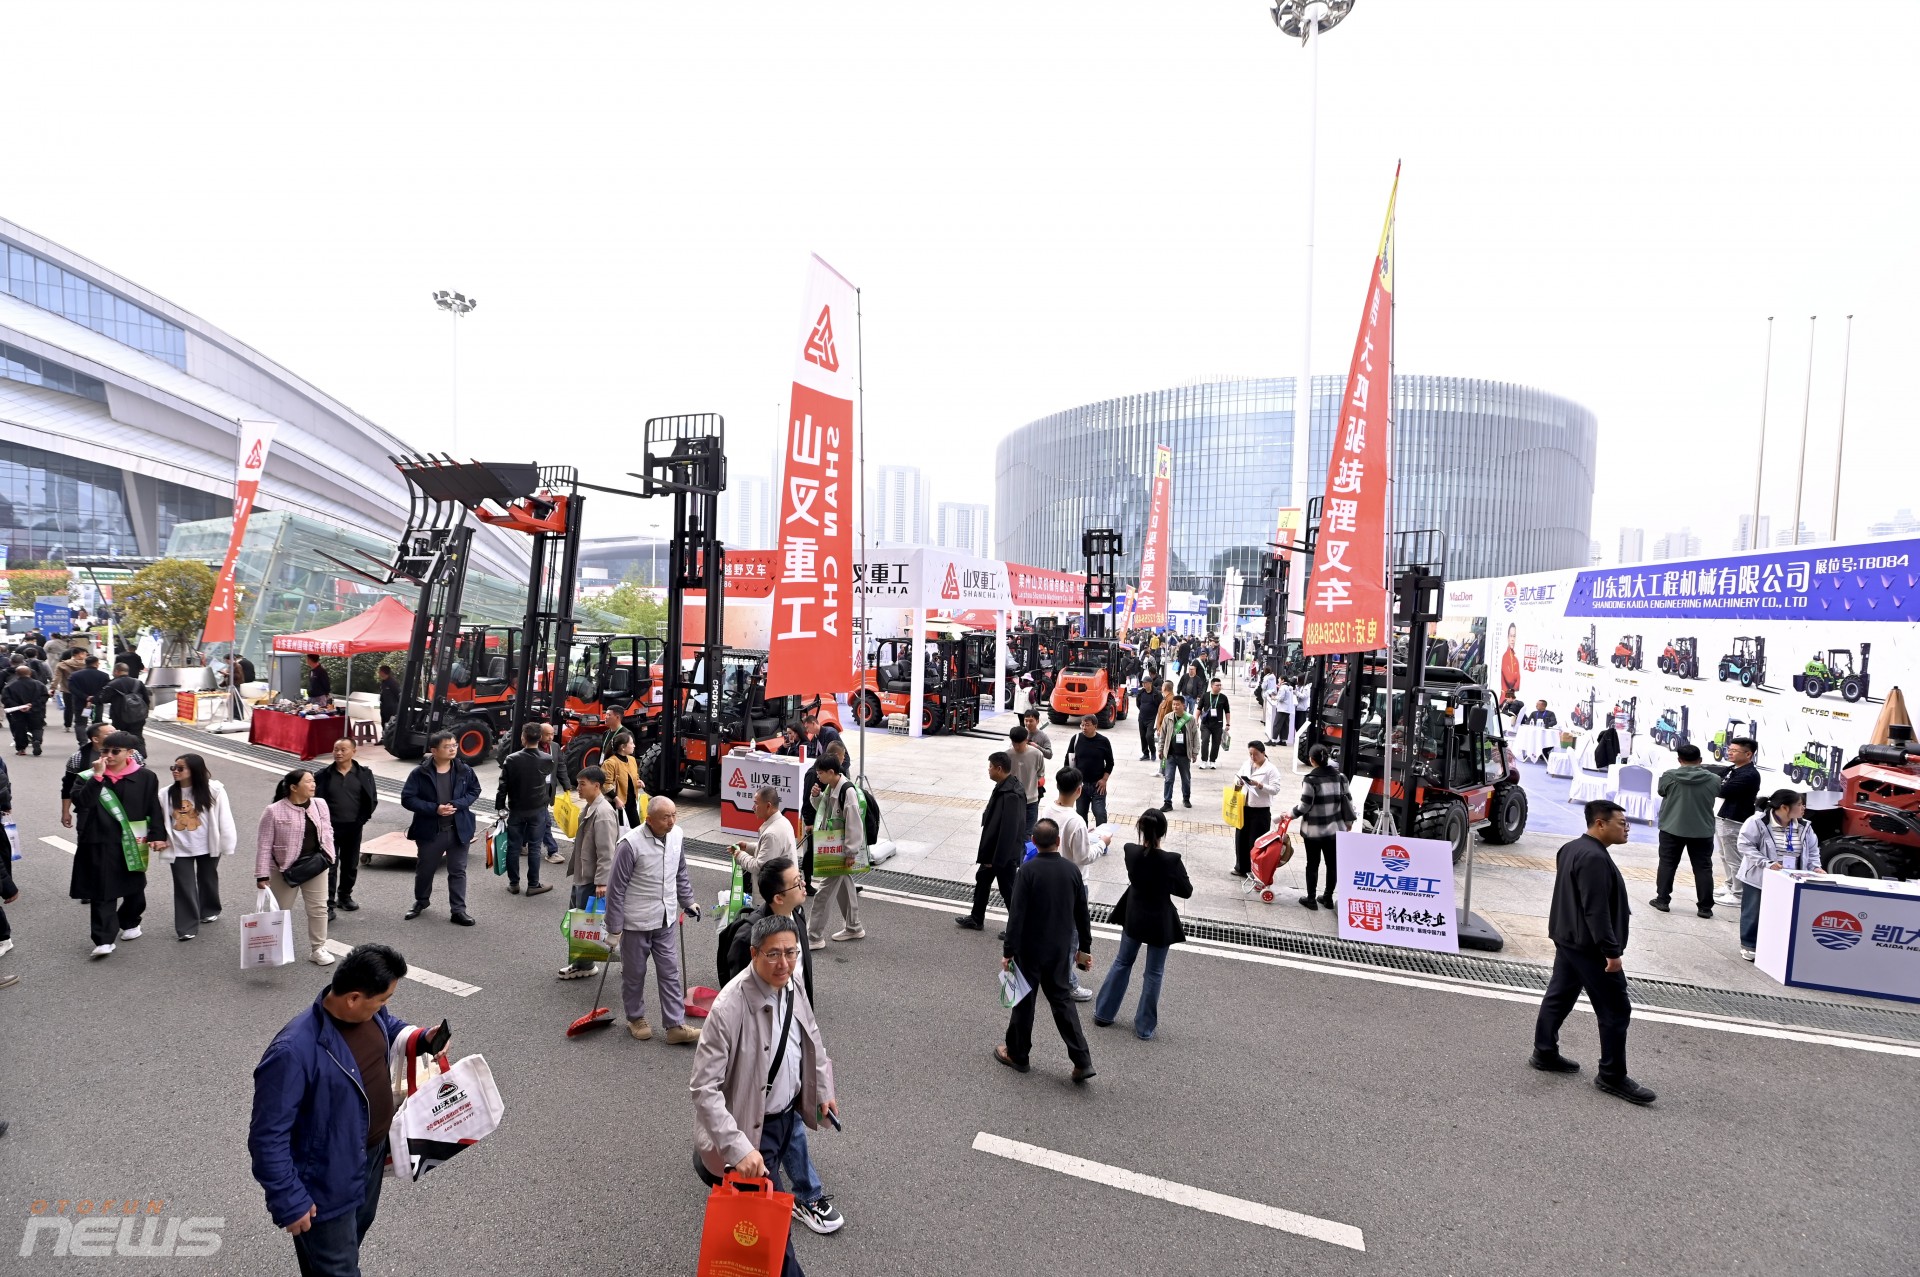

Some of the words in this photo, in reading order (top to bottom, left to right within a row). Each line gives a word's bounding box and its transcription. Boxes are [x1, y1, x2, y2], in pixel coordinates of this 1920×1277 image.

[963, 569, 997, 591] 山叉重工
[1592, 561, 1811, 599] 山东凯大工程机械有限公司
[963, 590, 996, 599] SHANCHA
[1449, 591, 1473, 602] MacDon
[1520, 584, 1557, 601] 凯大重工
[1592, 600, 1626, 609] SHANDONG
[1626, 600, 1649, 609] KAIDA
[1650, 599, 1702, 609] ENGINEERING
[1703, 597, 1760, 608] MACHINERY
[1785, 596, 1808, 608] LTD
[711, 679, 719, 718] CPCDY-50
[751, 771, 792, 788] 山叉重工
[1386, 848, 1406, 858] 凯大
[1353, 870, 1442, 895] 凯大重工
[1401, 890, 1435, 899] INDUSTRY
[1349, 900, 1382, 915] 越野
[1821, 915, 1856, 931] 凯大
[1875, 942, 1904, 950] KAIDA
[739, 1225, 756, 1237] 红日
